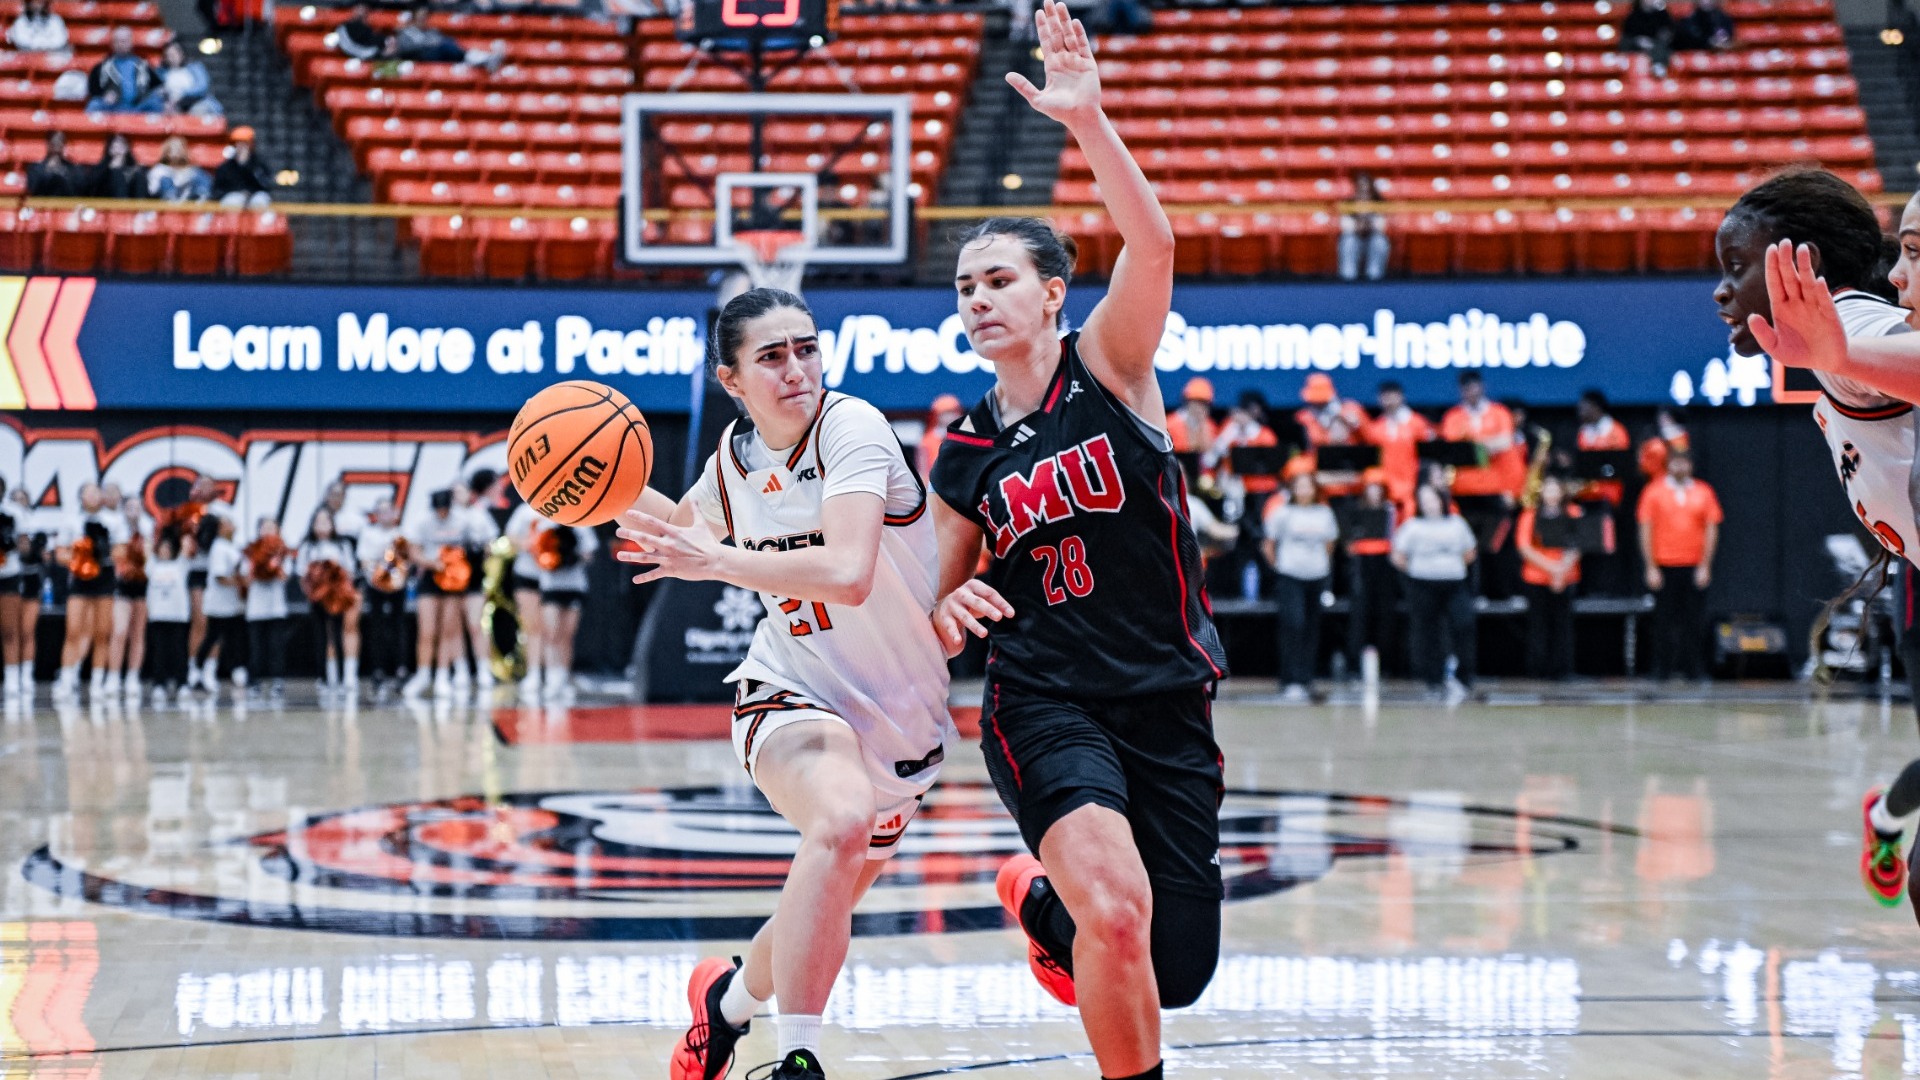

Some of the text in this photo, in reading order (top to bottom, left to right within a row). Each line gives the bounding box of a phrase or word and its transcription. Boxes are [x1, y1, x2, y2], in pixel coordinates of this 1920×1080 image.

[173, 310, 322, 371] Learn
[337, 312, 475, 374] More
[486, 320, 543, 374] at
[556, 315, 704, 375] Pacifi
[536, 455, 609, 518] Wilson
[978, 433, 1126, 559] LMU
[1031, 535, 1094, 606] 28
